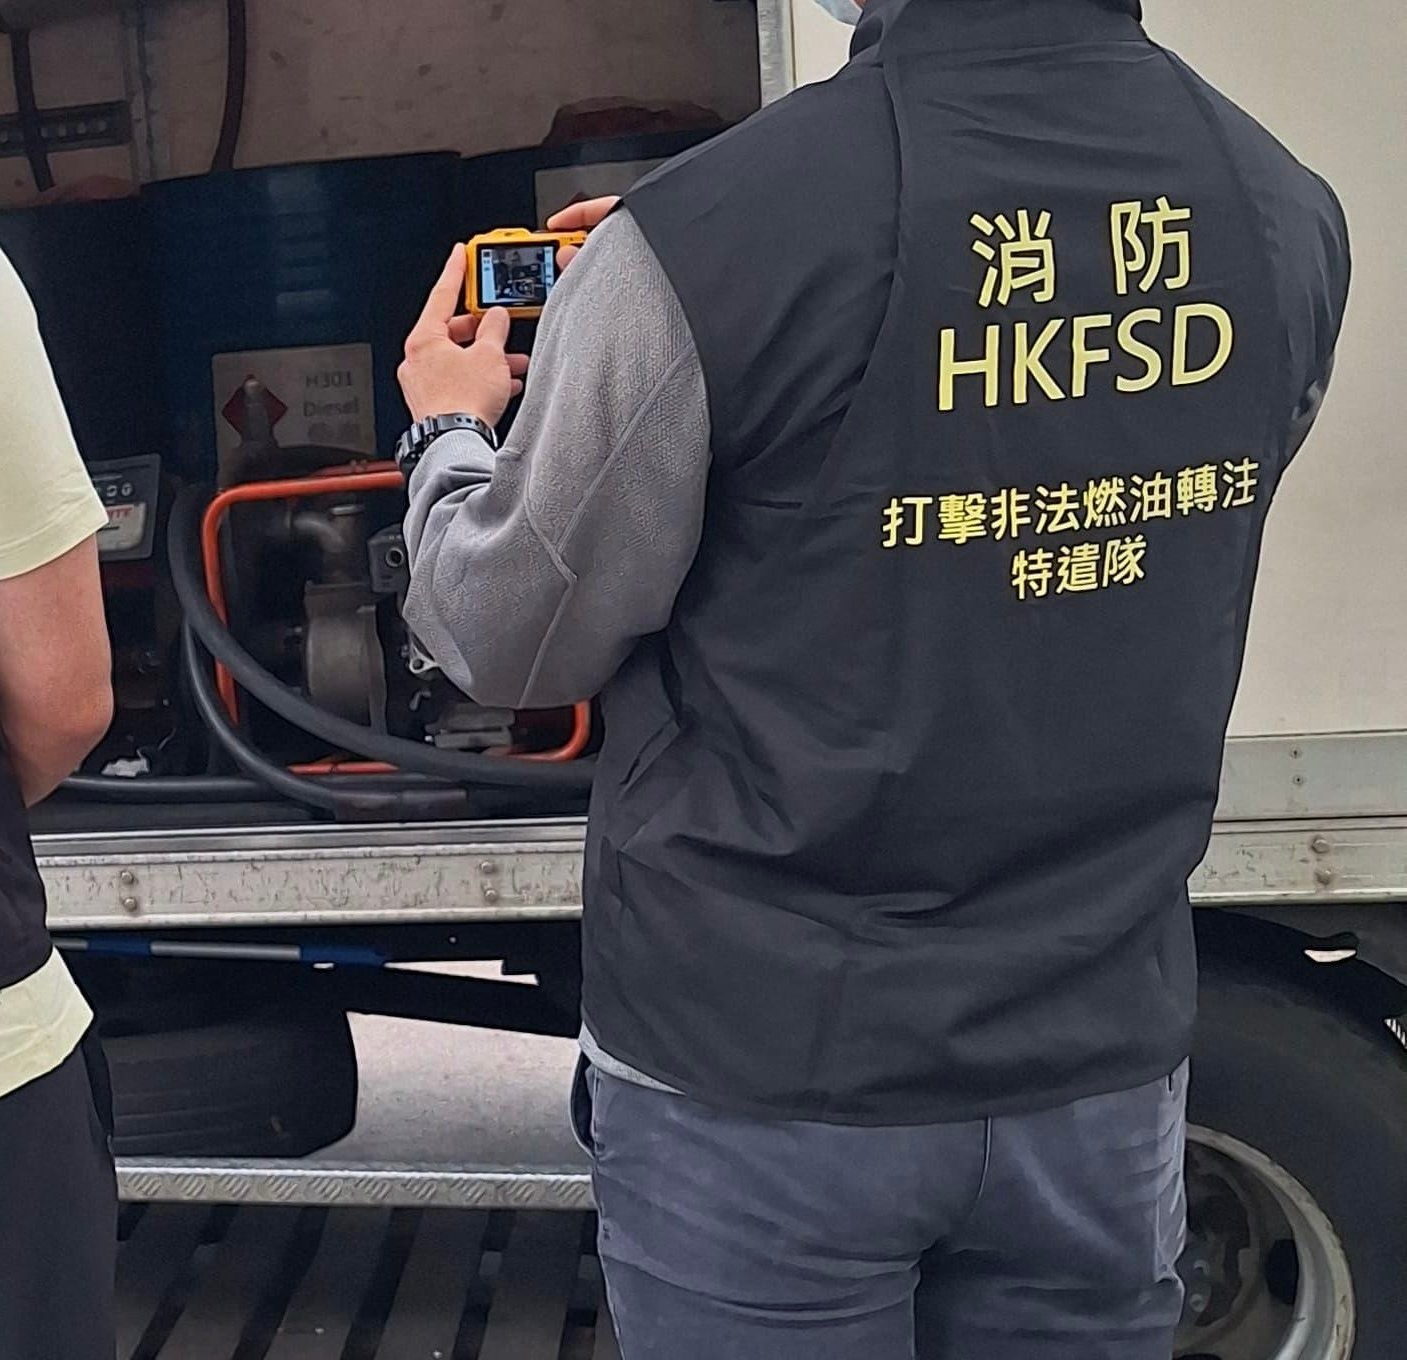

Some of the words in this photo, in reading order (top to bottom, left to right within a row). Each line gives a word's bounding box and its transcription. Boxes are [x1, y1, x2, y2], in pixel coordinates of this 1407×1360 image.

[969, 196, 1191, 308] 消防
[938, 304, 1233, 411] HKFSD
[882, 458, 1259, 548] 打擊非法燃油轉注
[1011, 535, 1146, 600] 特遣隊
